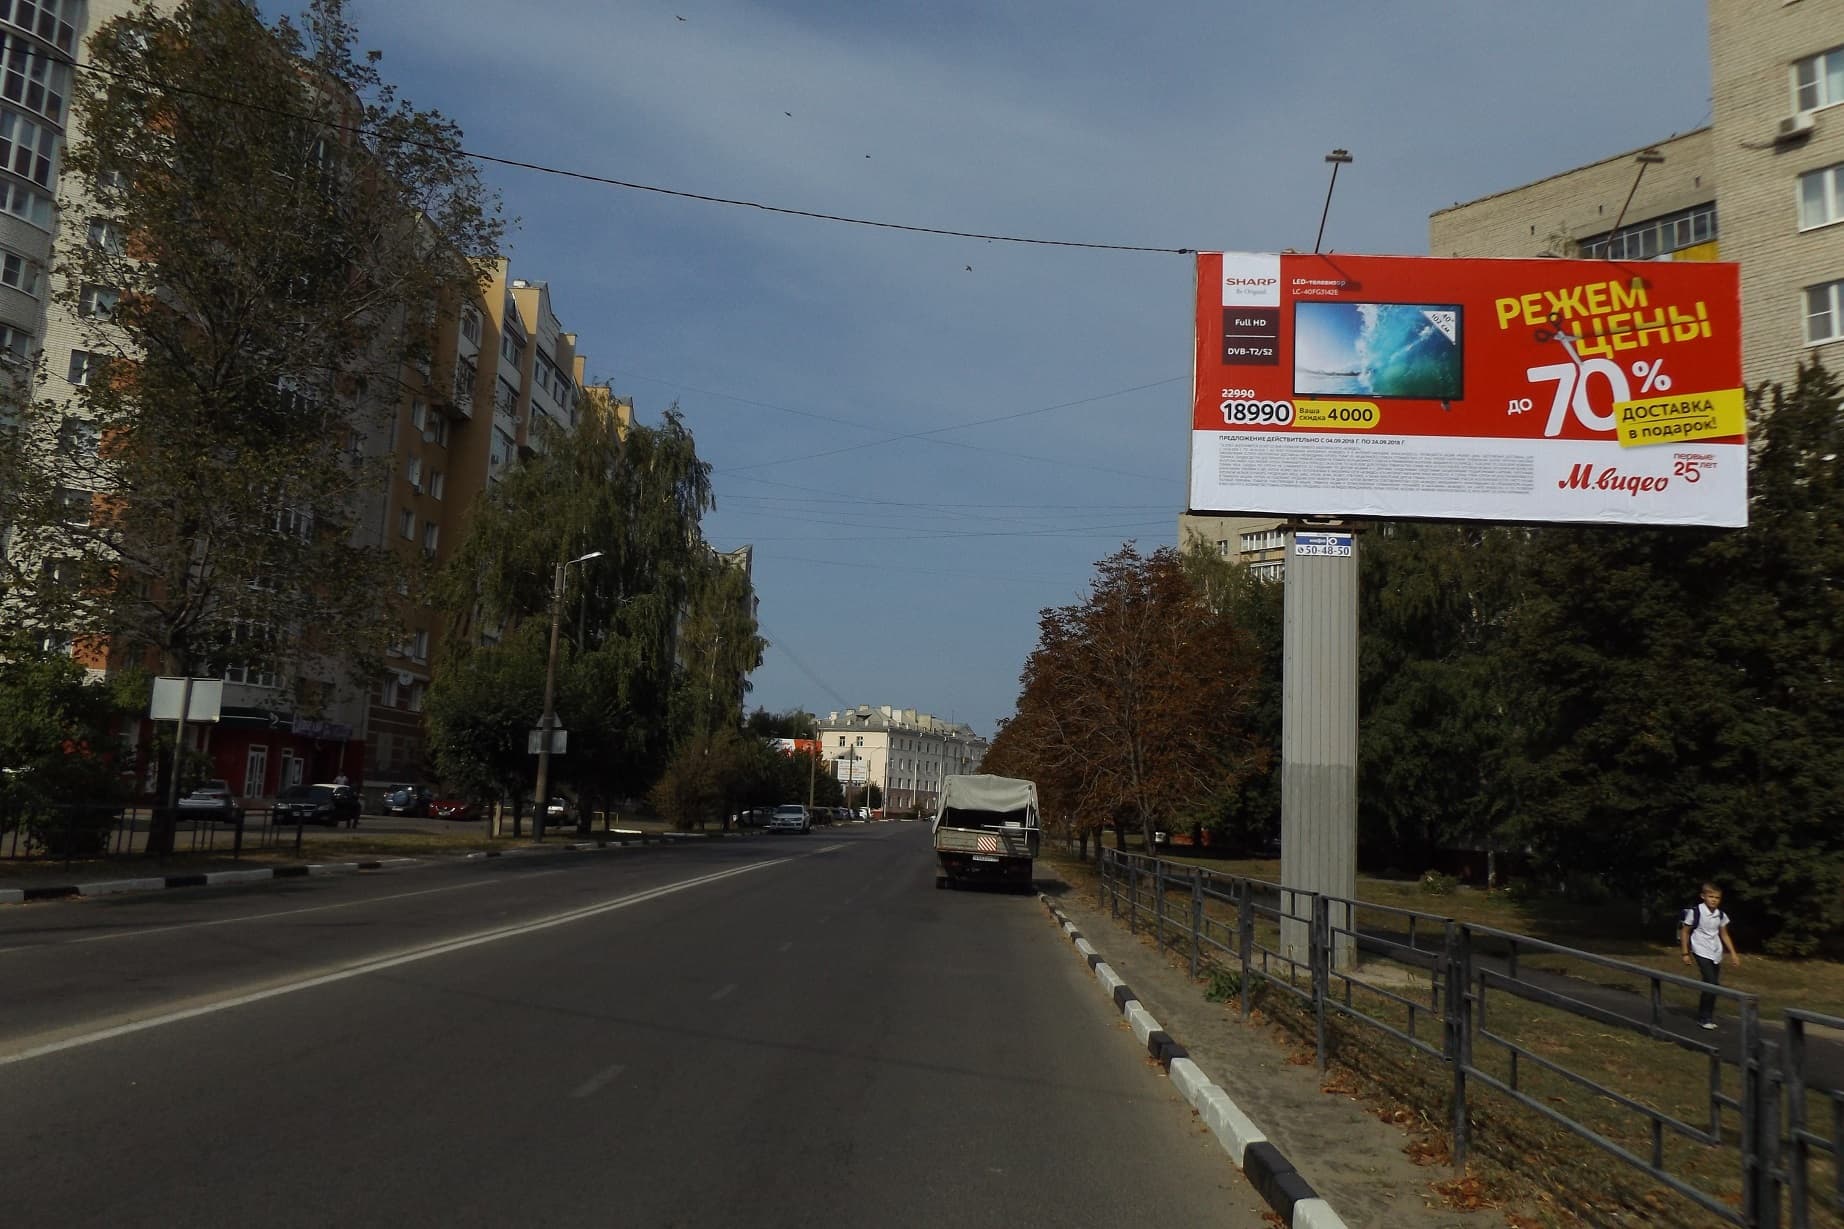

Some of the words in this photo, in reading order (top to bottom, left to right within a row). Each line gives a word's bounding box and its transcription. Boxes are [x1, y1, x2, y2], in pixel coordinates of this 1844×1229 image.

[1226, 278, 1277, 286] SHARP
[1495, 277, 1649, 330] РЕЖЕМ
[1235, 319, 1252, 327] Full
[1253, 319, 1267, 327] HD
[1571, 301, 1712, 359] ЦЕНЫ
[1227, 347, 1273, 357] DVB-T2/S2
[1221, 389, 1256, 398] 22990
[1223, 402, 1290, 423] 18990
[1299, 407, 1321, 415] Ваша
[1507, 398, 1533, 415] ДО
[1622, 400, 1714, 422] ДОСТАВКА
[1327, 408, 1374, 422] 4000
[1628, 428, 1637, 440] в
[1642, 417, 1718, 440] подарок!
[1673, 453, 1713, 461] первые
[1674, 461, 1700, 483] 25
[1558, 463, 1669, 497] М.видео
[1305, 545, 1350, 556] 50-48-50
